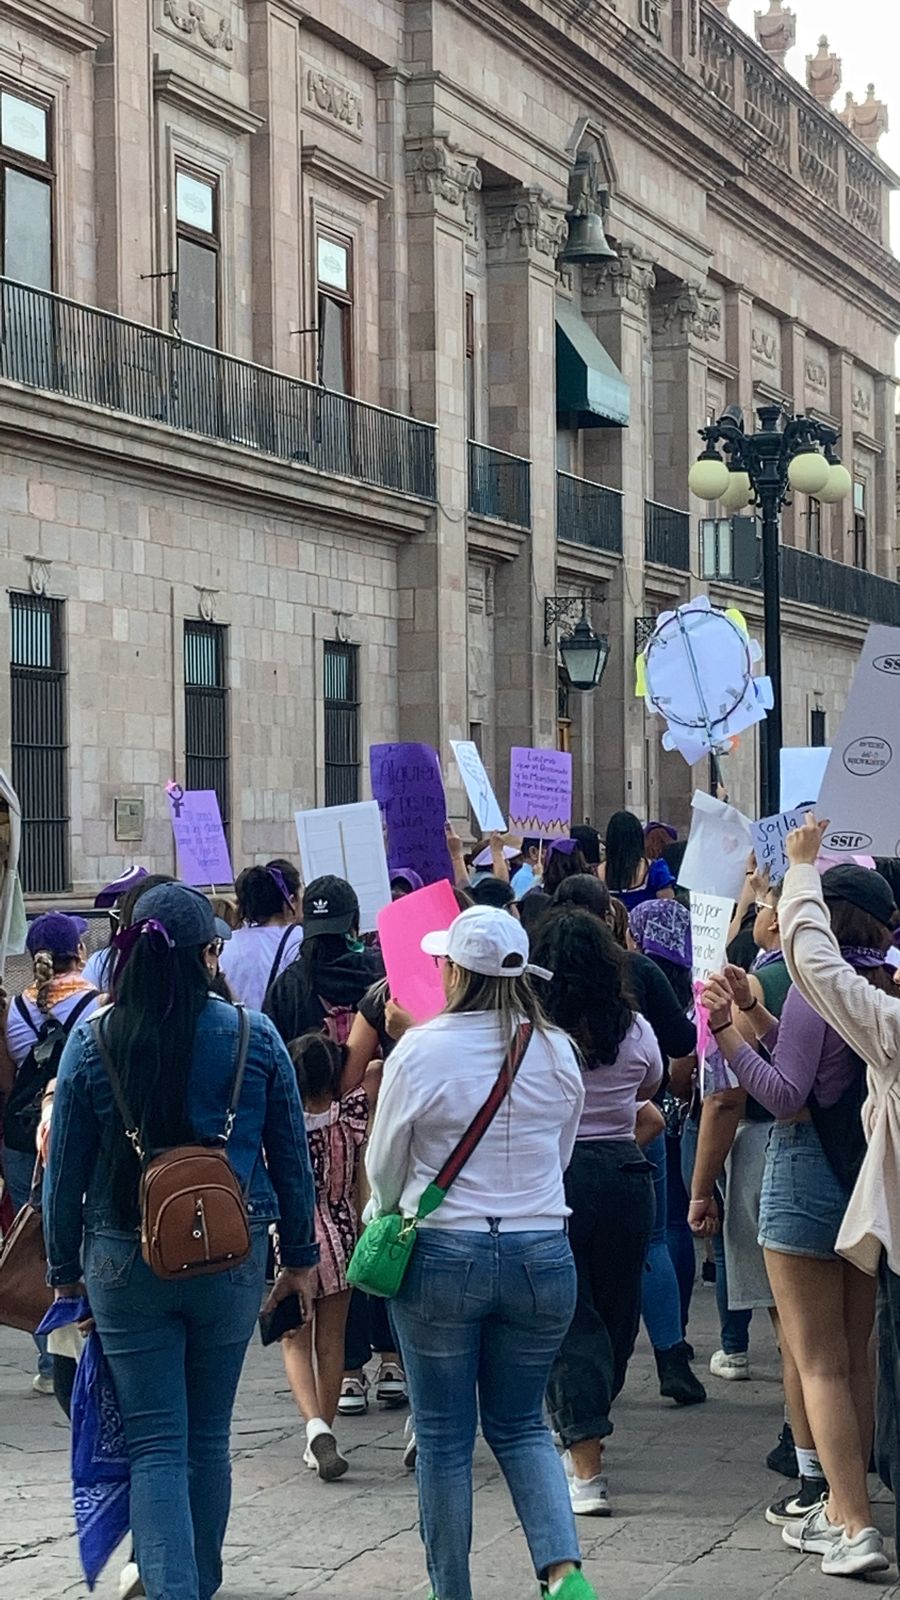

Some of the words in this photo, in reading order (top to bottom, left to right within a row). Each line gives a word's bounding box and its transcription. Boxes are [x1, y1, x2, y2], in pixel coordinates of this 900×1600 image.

[757, 821, 783, 842] Soy
[783, 815, 799, 831] la
[830, 835, 863, 847] JISS
[762, 843, 776, 858] de
[704, 904, 723, 923] por
[704, 944, 716, 960] de
